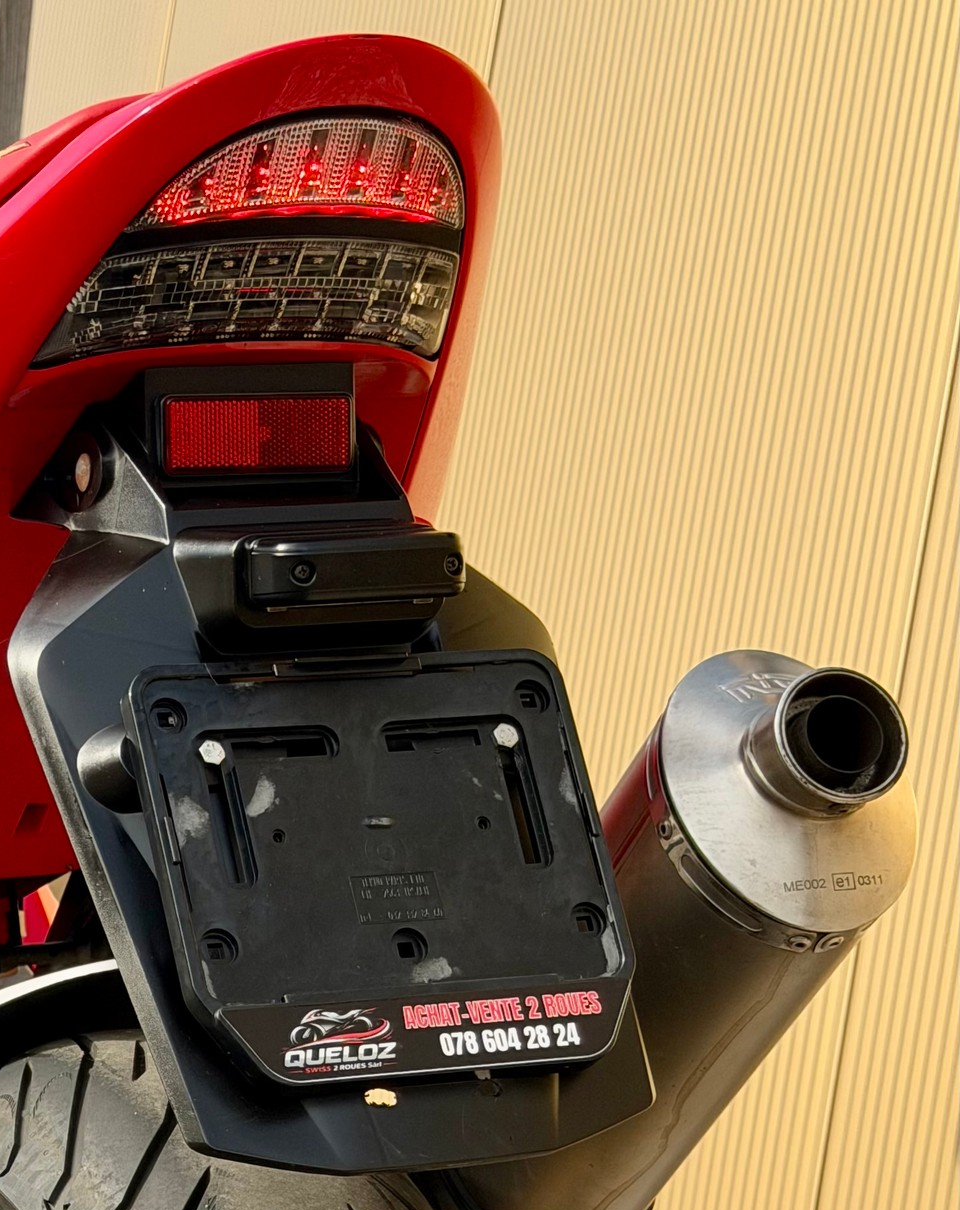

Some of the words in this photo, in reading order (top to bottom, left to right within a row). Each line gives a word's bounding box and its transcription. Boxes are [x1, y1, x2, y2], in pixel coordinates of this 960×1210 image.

[857, 874, 883, 886] 0311
[403, 997, 524, 1029] ACHAT-VENTE
[525, 996, 541, 1020] 2
[542, 991, 602, 1018] ROUES
[439, 1030, 479, 1056] 078
[481, 1026, 522, 1053] 604
[523, 1022, 550, 1050] 28
[552, 1021, 581, 1047] 24
[284, 1042, 397, 1068] QUELOZ
[339, 1062, 367, 1071] ROUES
